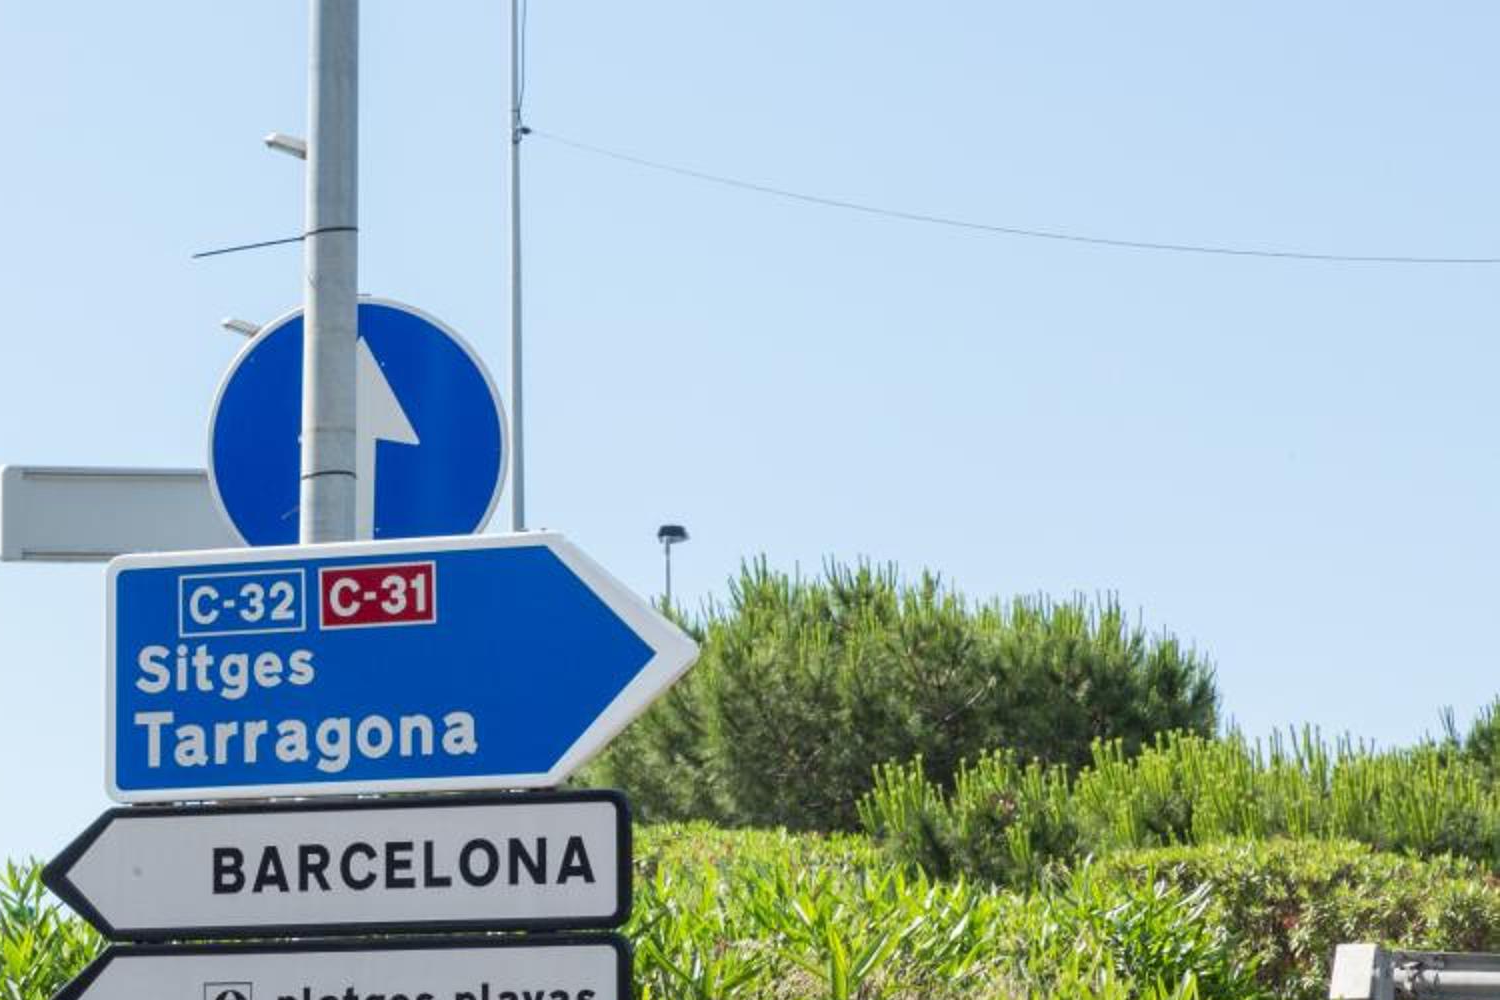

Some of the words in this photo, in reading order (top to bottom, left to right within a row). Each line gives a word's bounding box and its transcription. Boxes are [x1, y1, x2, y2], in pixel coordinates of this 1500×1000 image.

[189, 581, 296, 625] C-32
[328, 573, 428, 617] C-31
[135, 644, 316, 700] Sitges
[134, 710, 479, 774] Tarragona
[211, 835, 597, 895] BARCELONA
